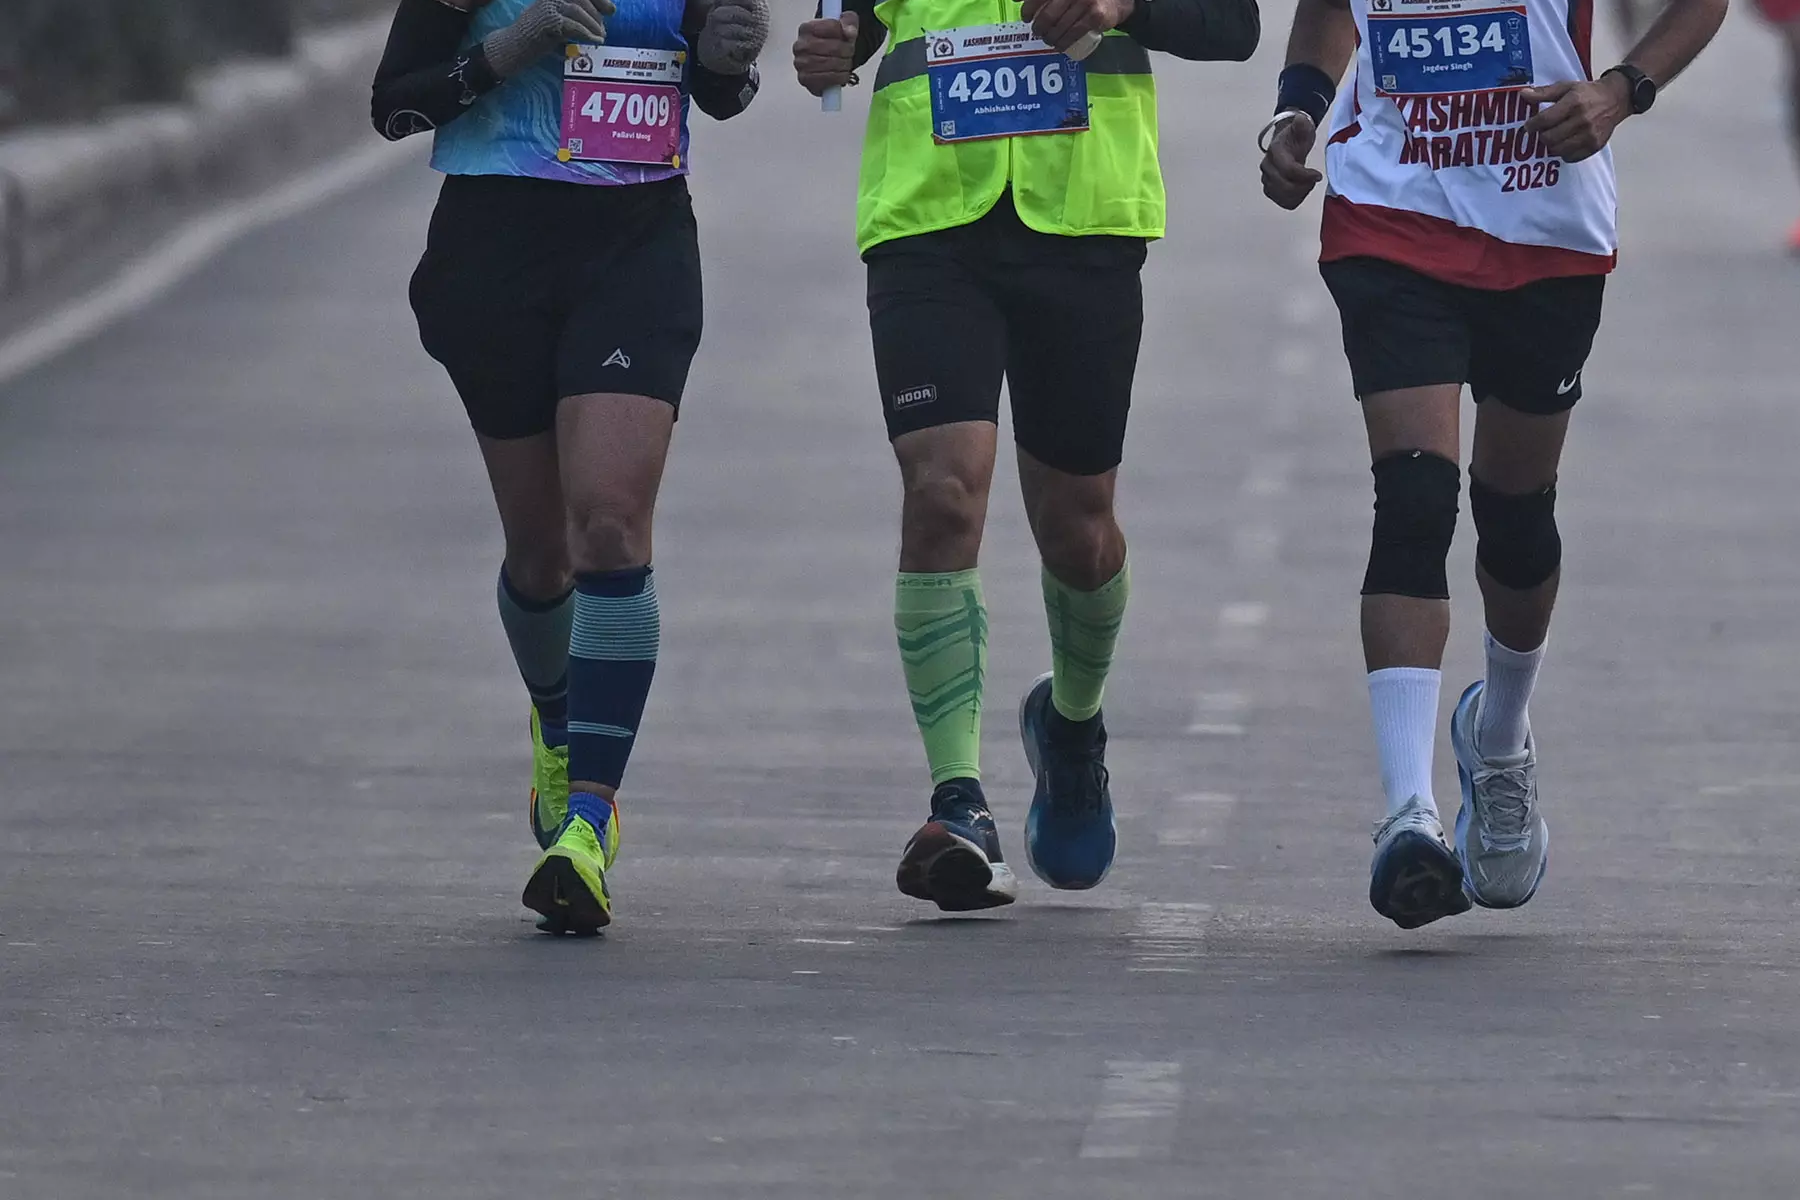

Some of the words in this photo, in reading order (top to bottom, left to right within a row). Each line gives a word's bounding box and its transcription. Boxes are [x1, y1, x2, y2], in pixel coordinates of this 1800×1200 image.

[963, 35, 993, 48] KASHMIR
[993, 33, 1030, 45] MARATHON
[1387, 21, 1505, 59] 45134
[948, 62, 1064, 103] 42016
[1422, 63, 1449, 73] Jagdev
[1450, 62, 1473, 71] Singh
[580, 91, 670, 127] 47009
[974, 104, 1016, 115] Abhishake
[1017, 103, 1041, 113] Gupta
[1501, 159, 1561, 193] 2026
